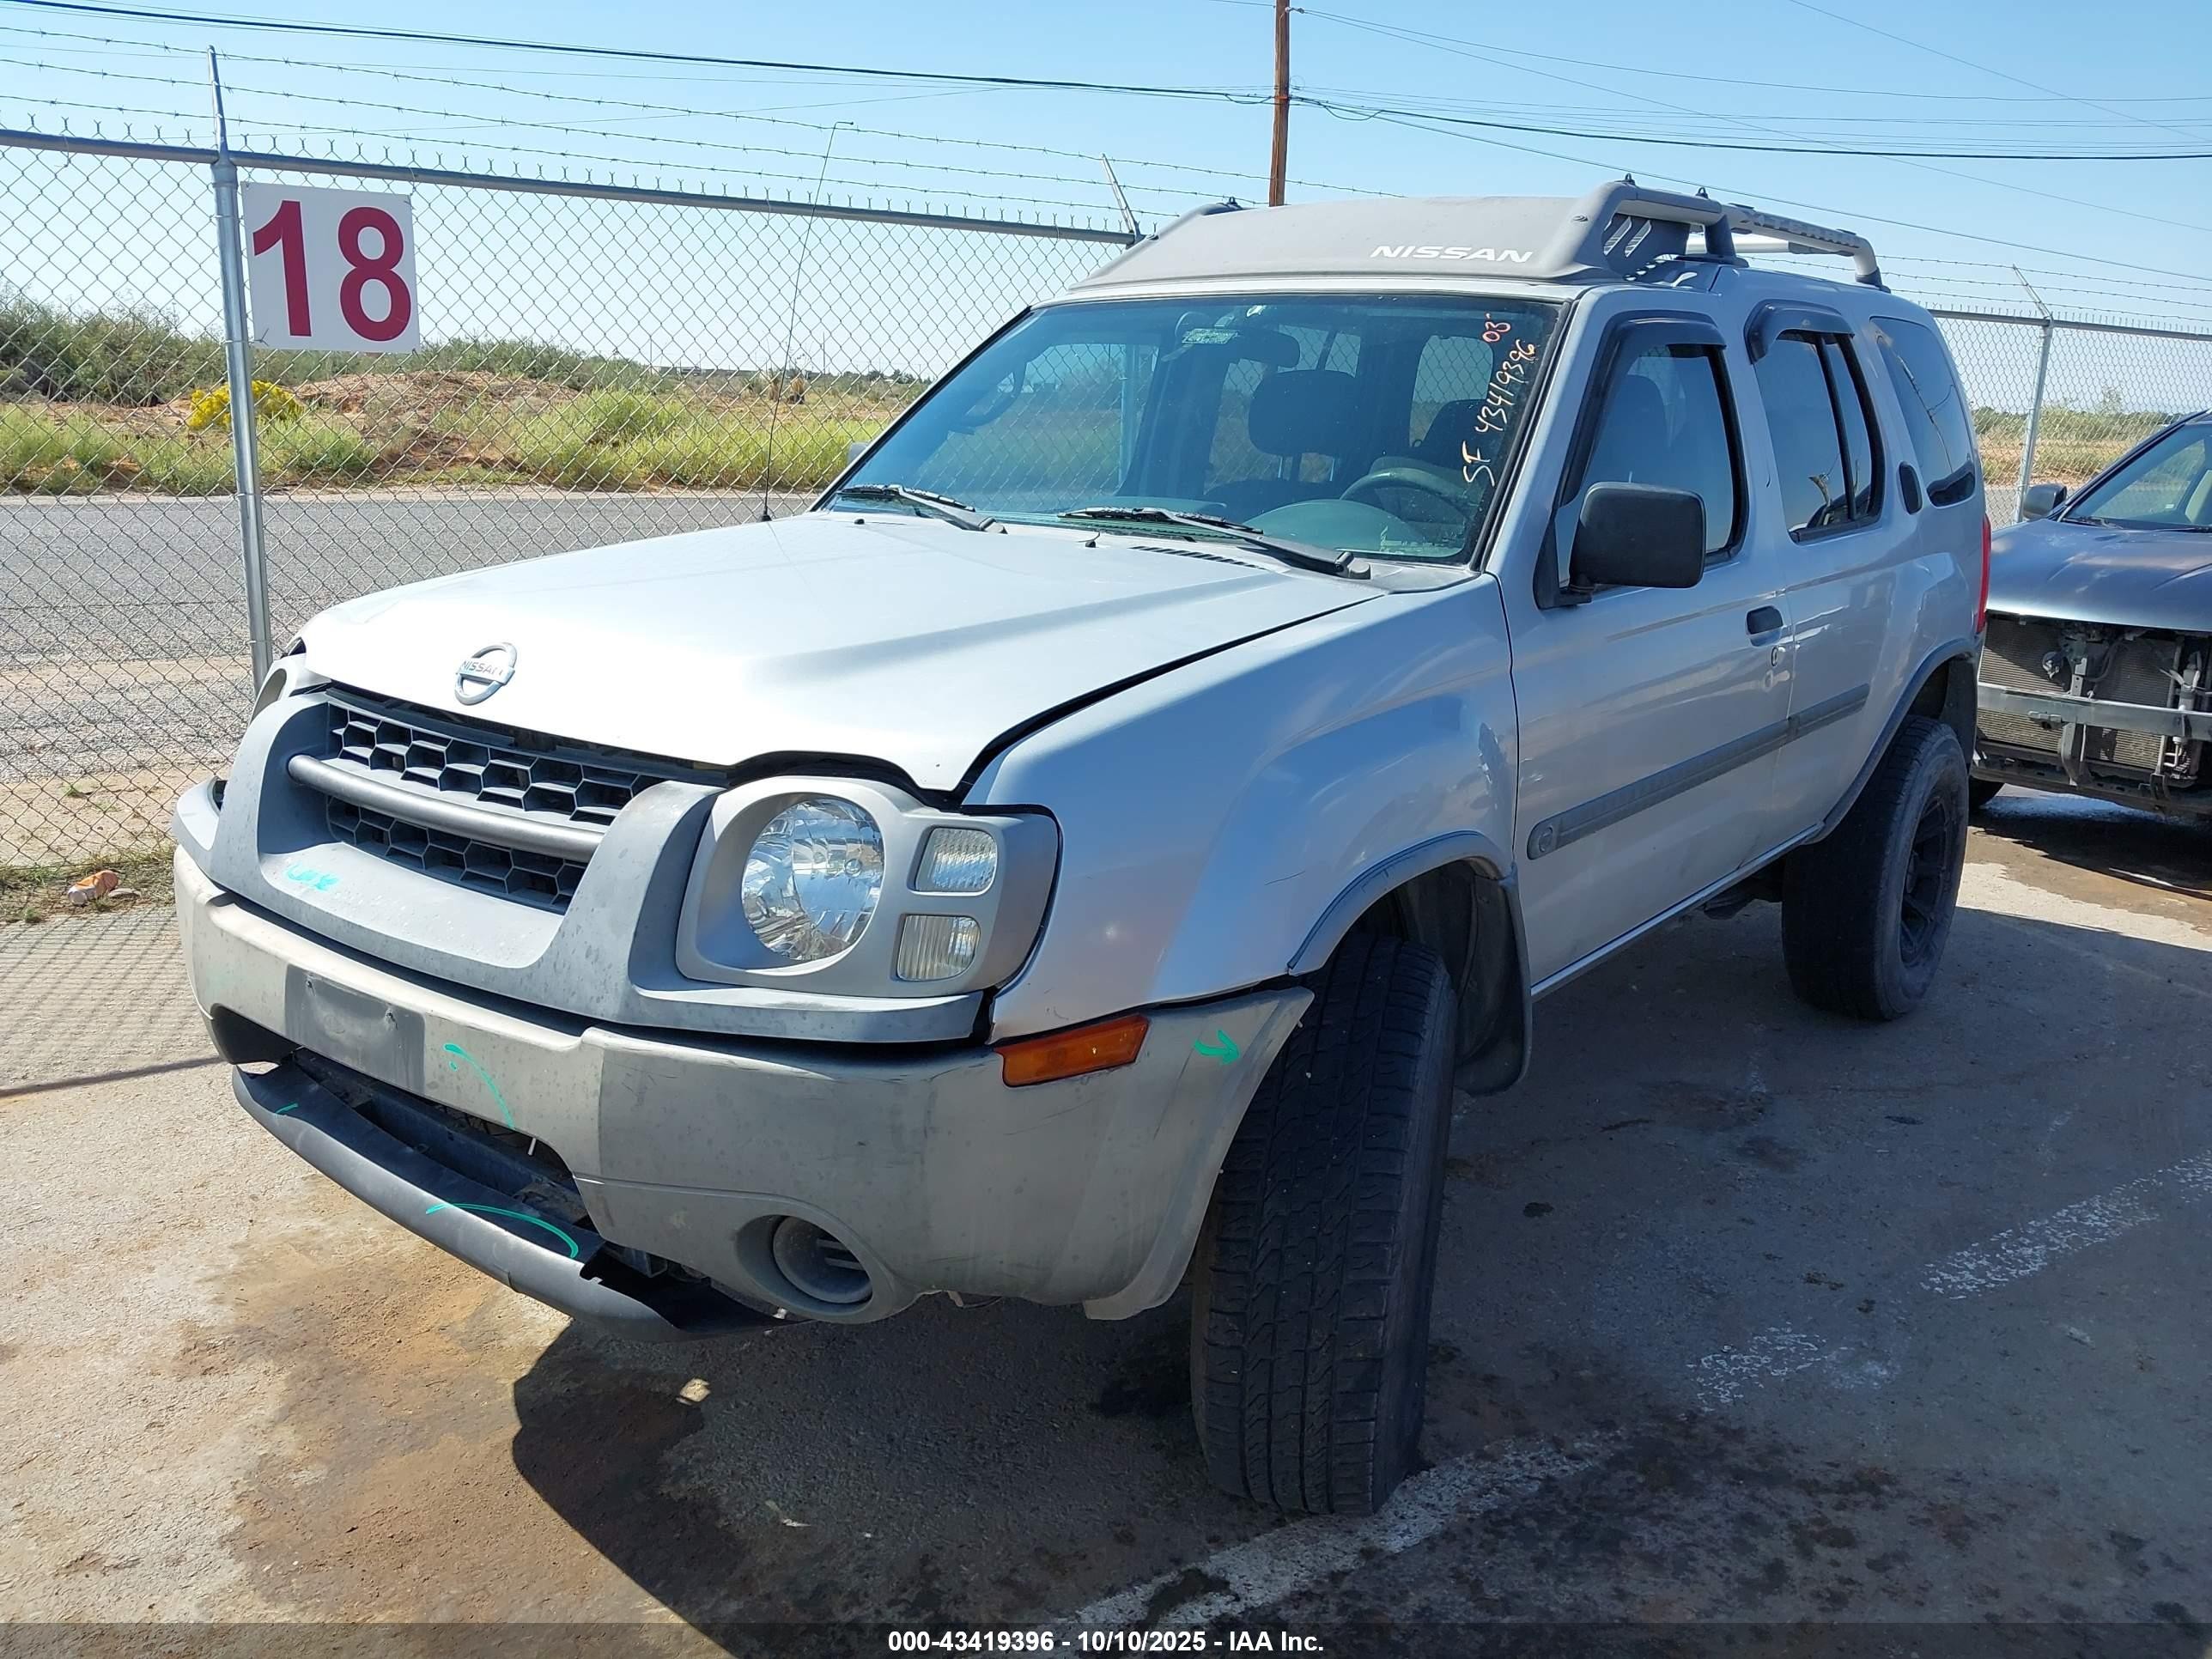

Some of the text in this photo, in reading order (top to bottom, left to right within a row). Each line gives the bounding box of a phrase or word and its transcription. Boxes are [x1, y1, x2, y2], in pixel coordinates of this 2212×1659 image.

[252, 199, 412, 342] 18
[1370, 246, 1533, 263] NISSAN
[1474, 338, 1535, 432] 43419396
[461, 659, 504, 676] NISSAN
